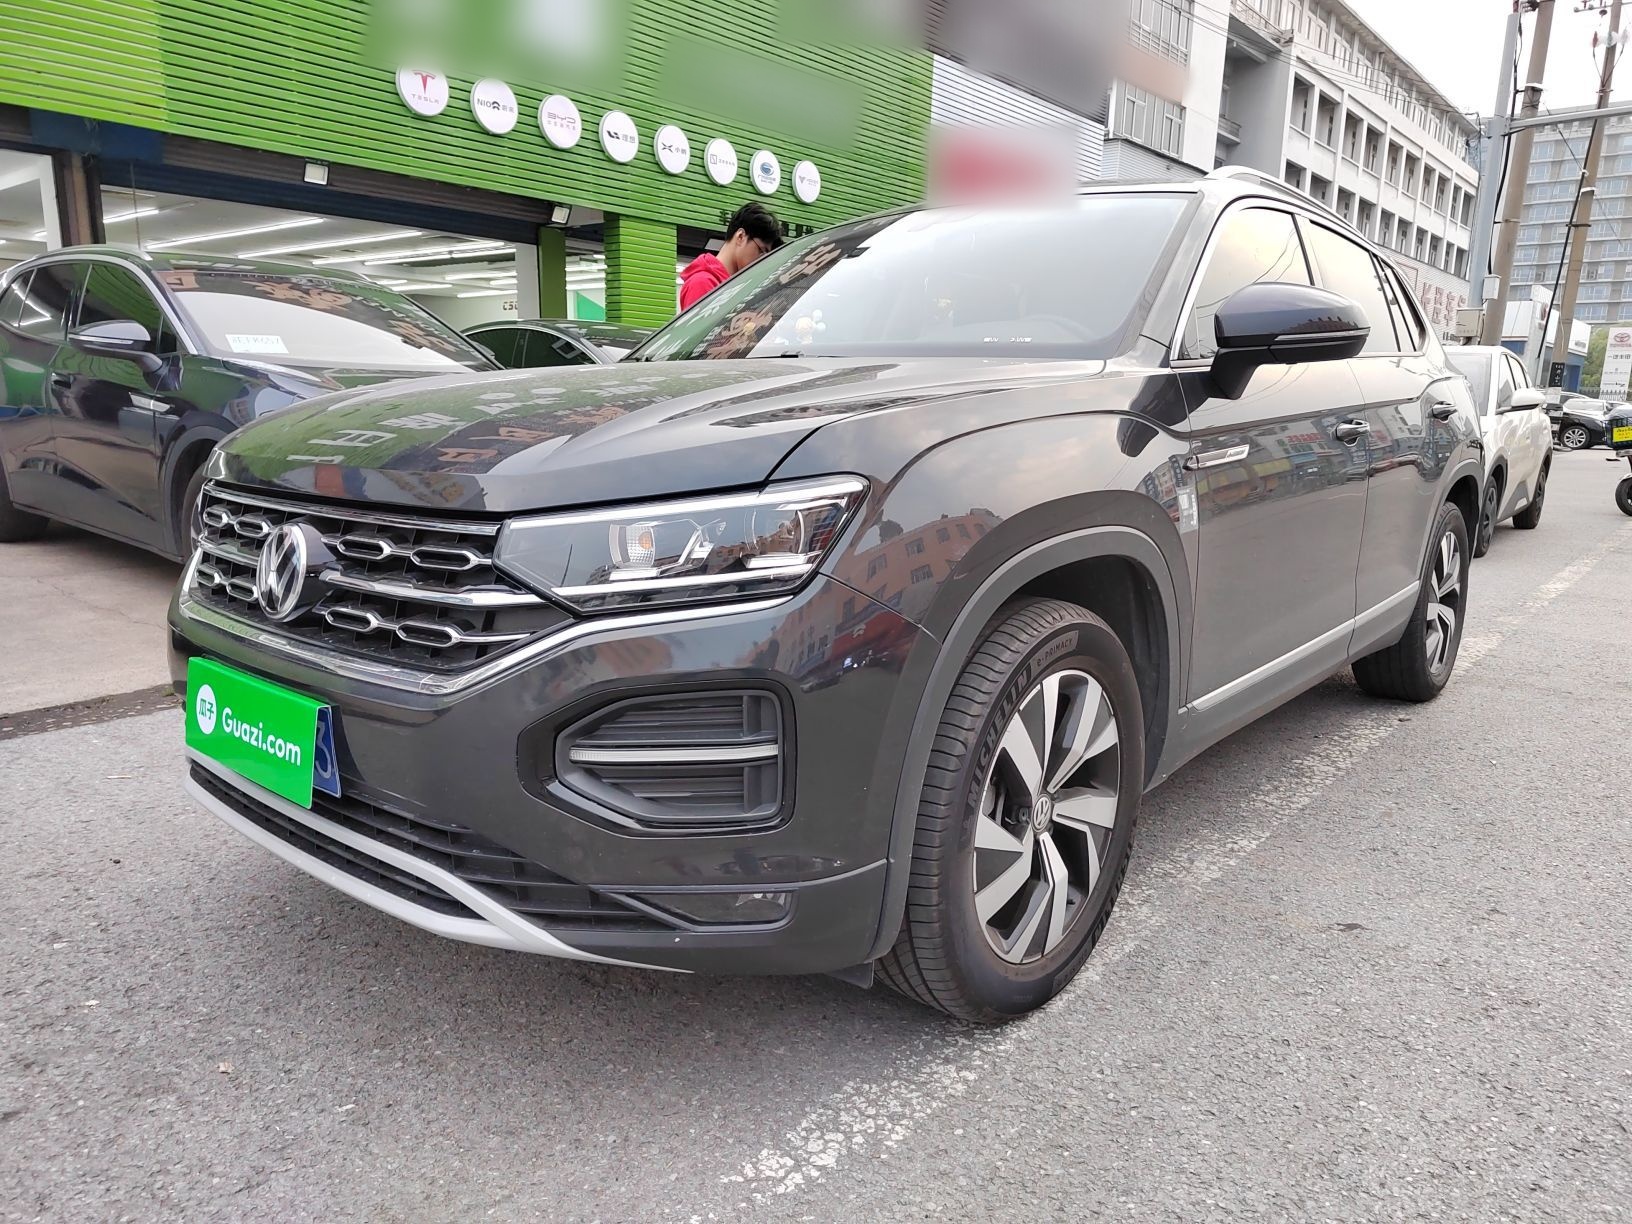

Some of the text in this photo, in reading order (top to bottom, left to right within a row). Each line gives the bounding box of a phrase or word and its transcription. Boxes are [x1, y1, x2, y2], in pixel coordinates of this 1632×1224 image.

[411, 93, 440, 105] TESLA
[477, 98, 492, 108] NIO
[547, 111, 576, 125] BYD
[198, 697, 302, 767] 瓜子 Guazi.com
[967, 668, 1029, 809] MICHELIN
